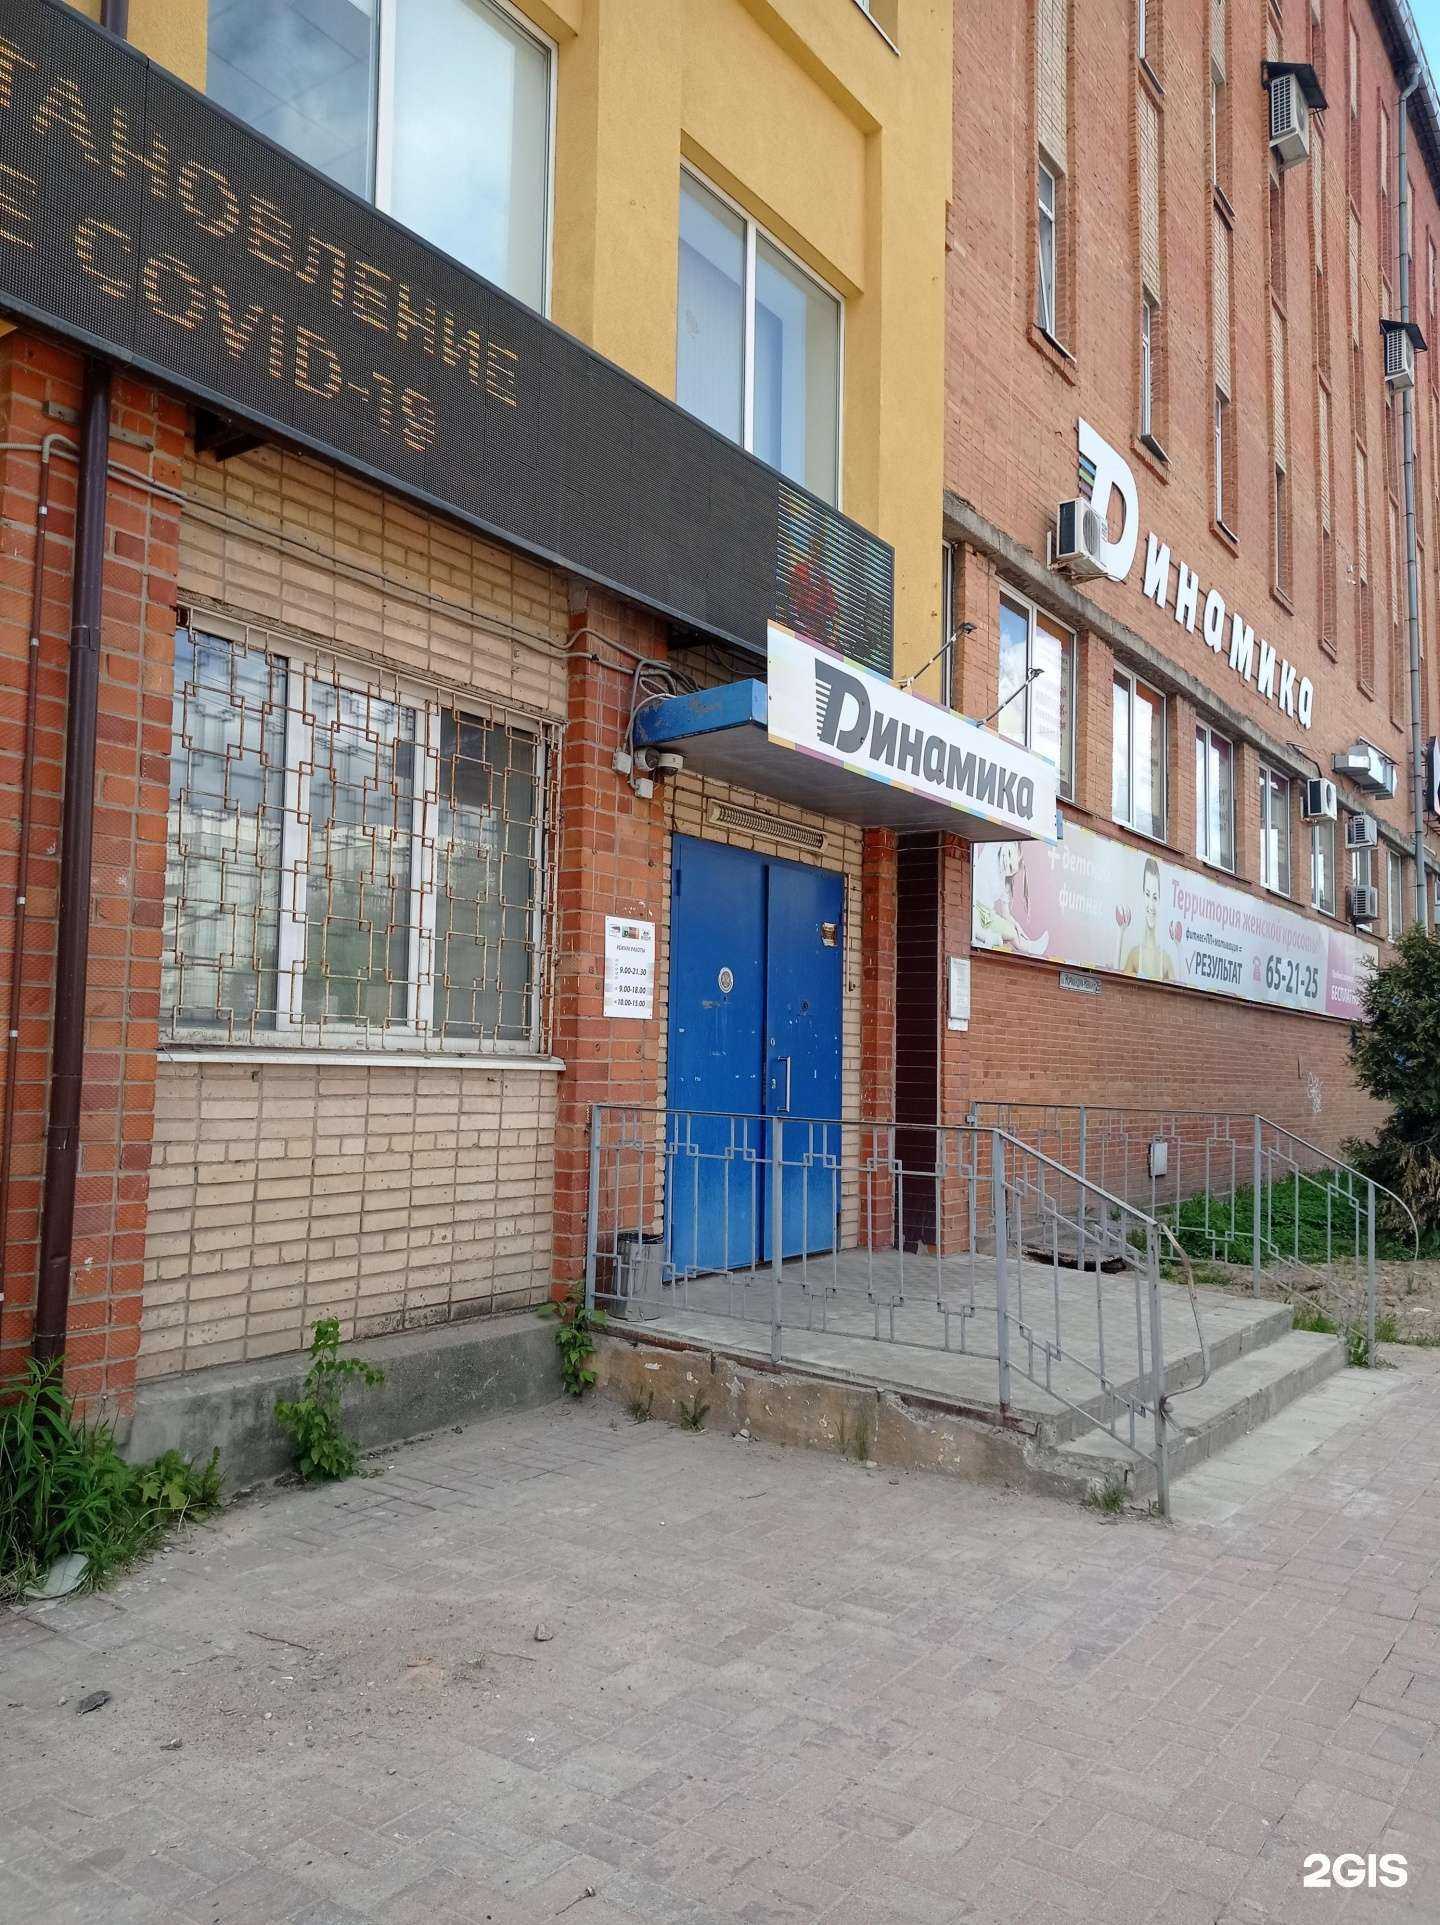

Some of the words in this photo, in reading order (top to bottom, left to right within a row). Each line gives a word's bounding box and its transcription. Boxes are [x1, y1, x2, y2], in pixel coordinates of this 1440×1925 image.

[1171, 878, 1241, 931] Территория
[1242, 911, 1281, 942] женской
[1195, 951, 1243, 985] РЕЗУЛЬТАТ
[1265, 954, 1319, 999] 65-21-25
